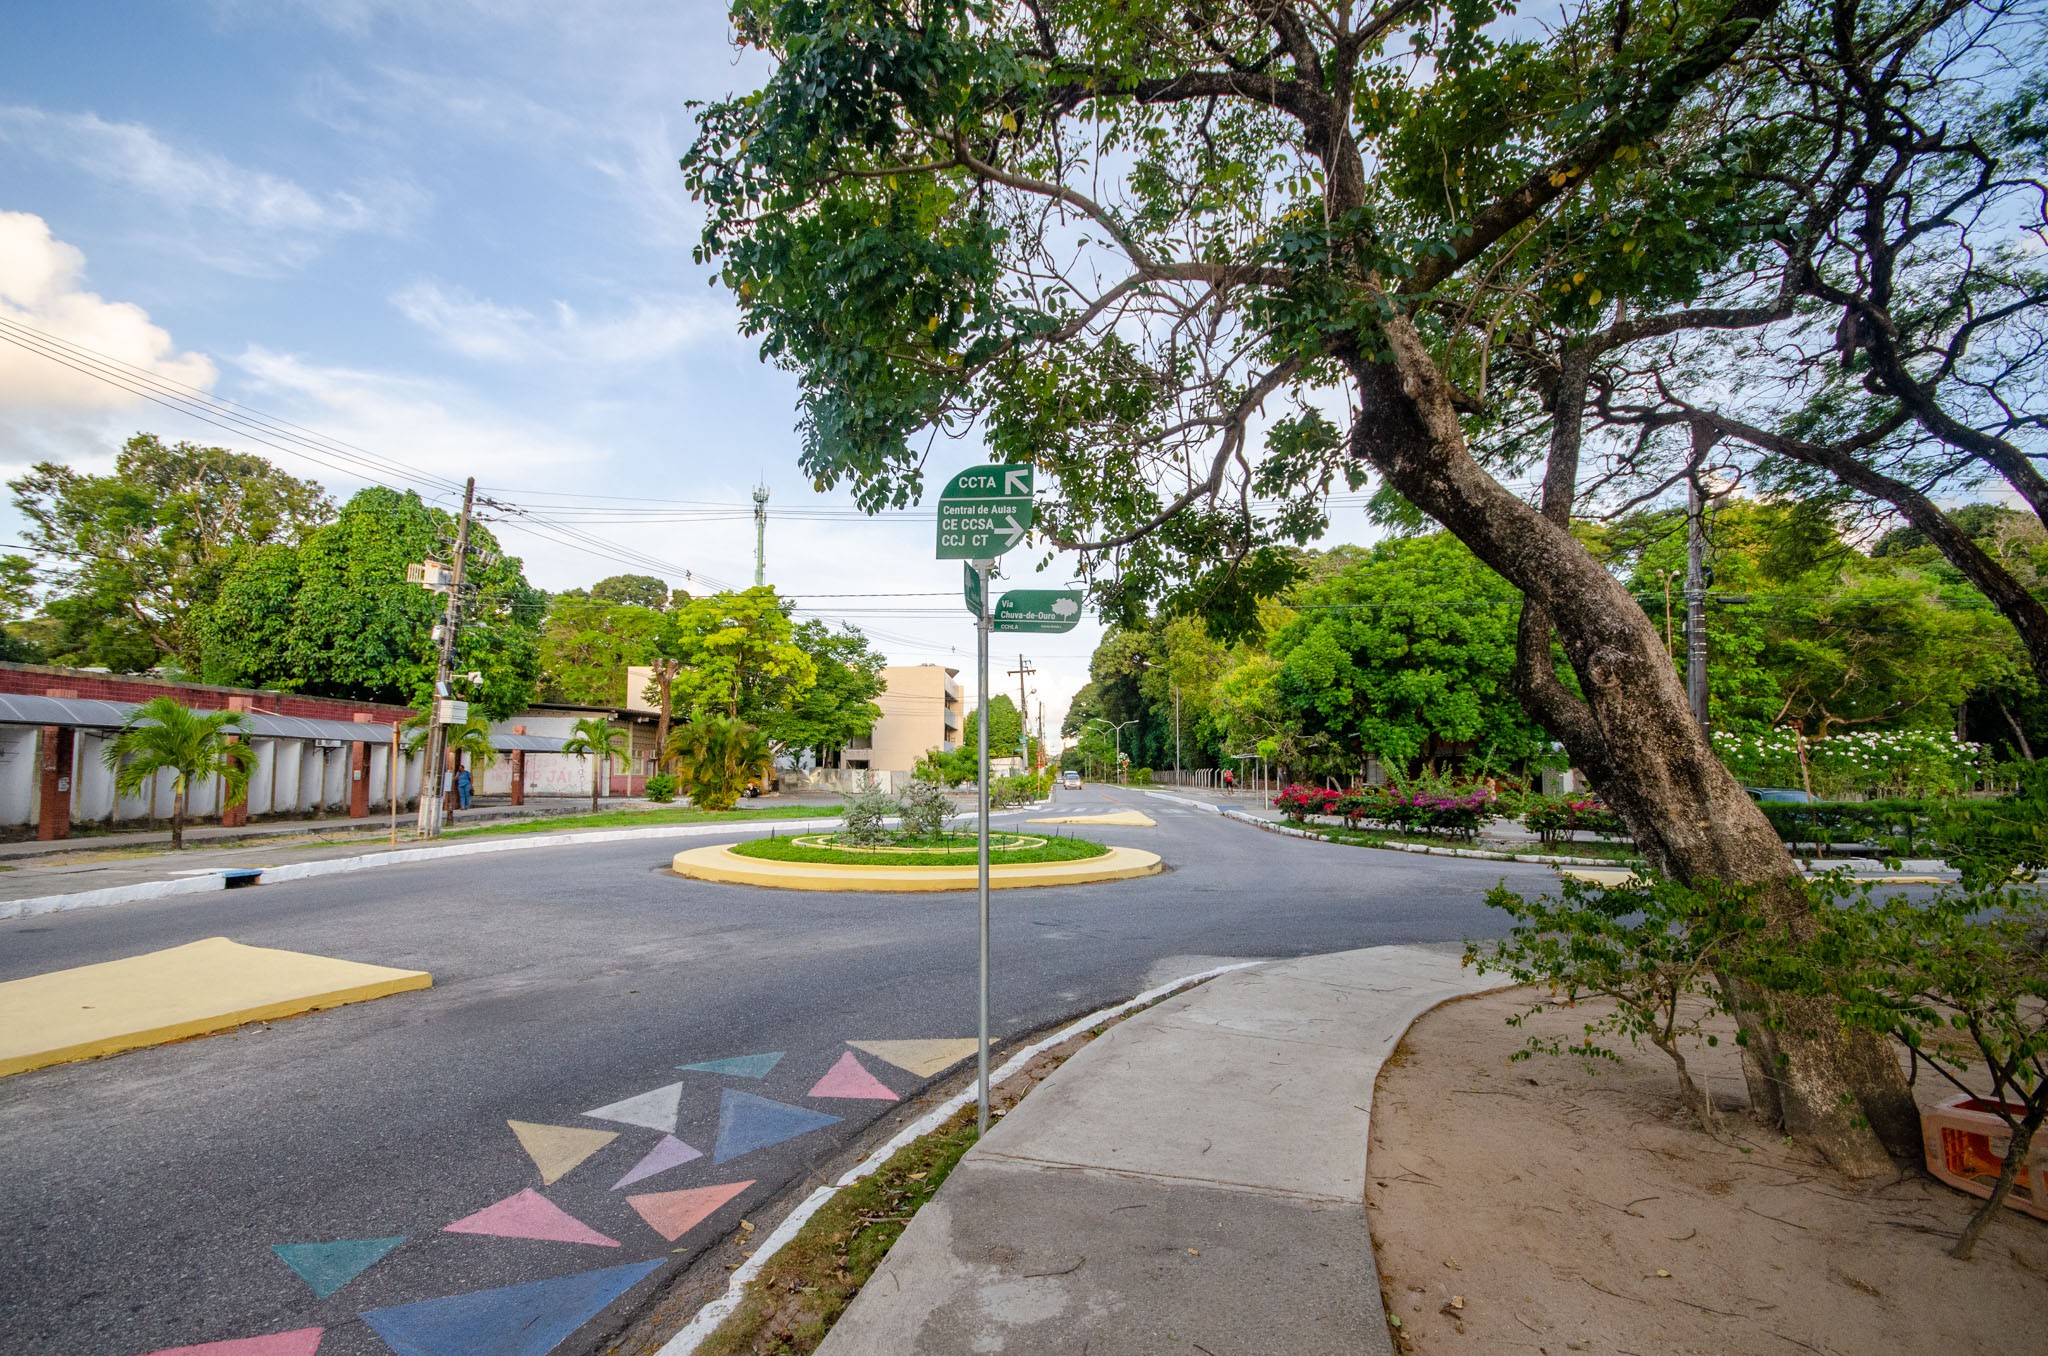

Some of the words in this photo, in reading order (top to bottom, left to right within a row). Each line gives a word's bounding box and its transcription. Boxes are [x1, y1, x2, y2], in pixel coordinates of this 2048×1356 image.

[958, 476, 997, 489] CCTA
[943, 505, 976, 515] Central
[977, 504, 989, 514] de
[991, 504, 1017, 514] Aulas
[942, 519, 959, 531] CE
[961, 518, 995, 530] CCSA
[941, 534, 966, 547] CCJ
[972, 534, 989, 547] CT
[1001, 600, 1014, 608] Via
[1000, 611, 1056, 620] Chuva-de-Ouro
